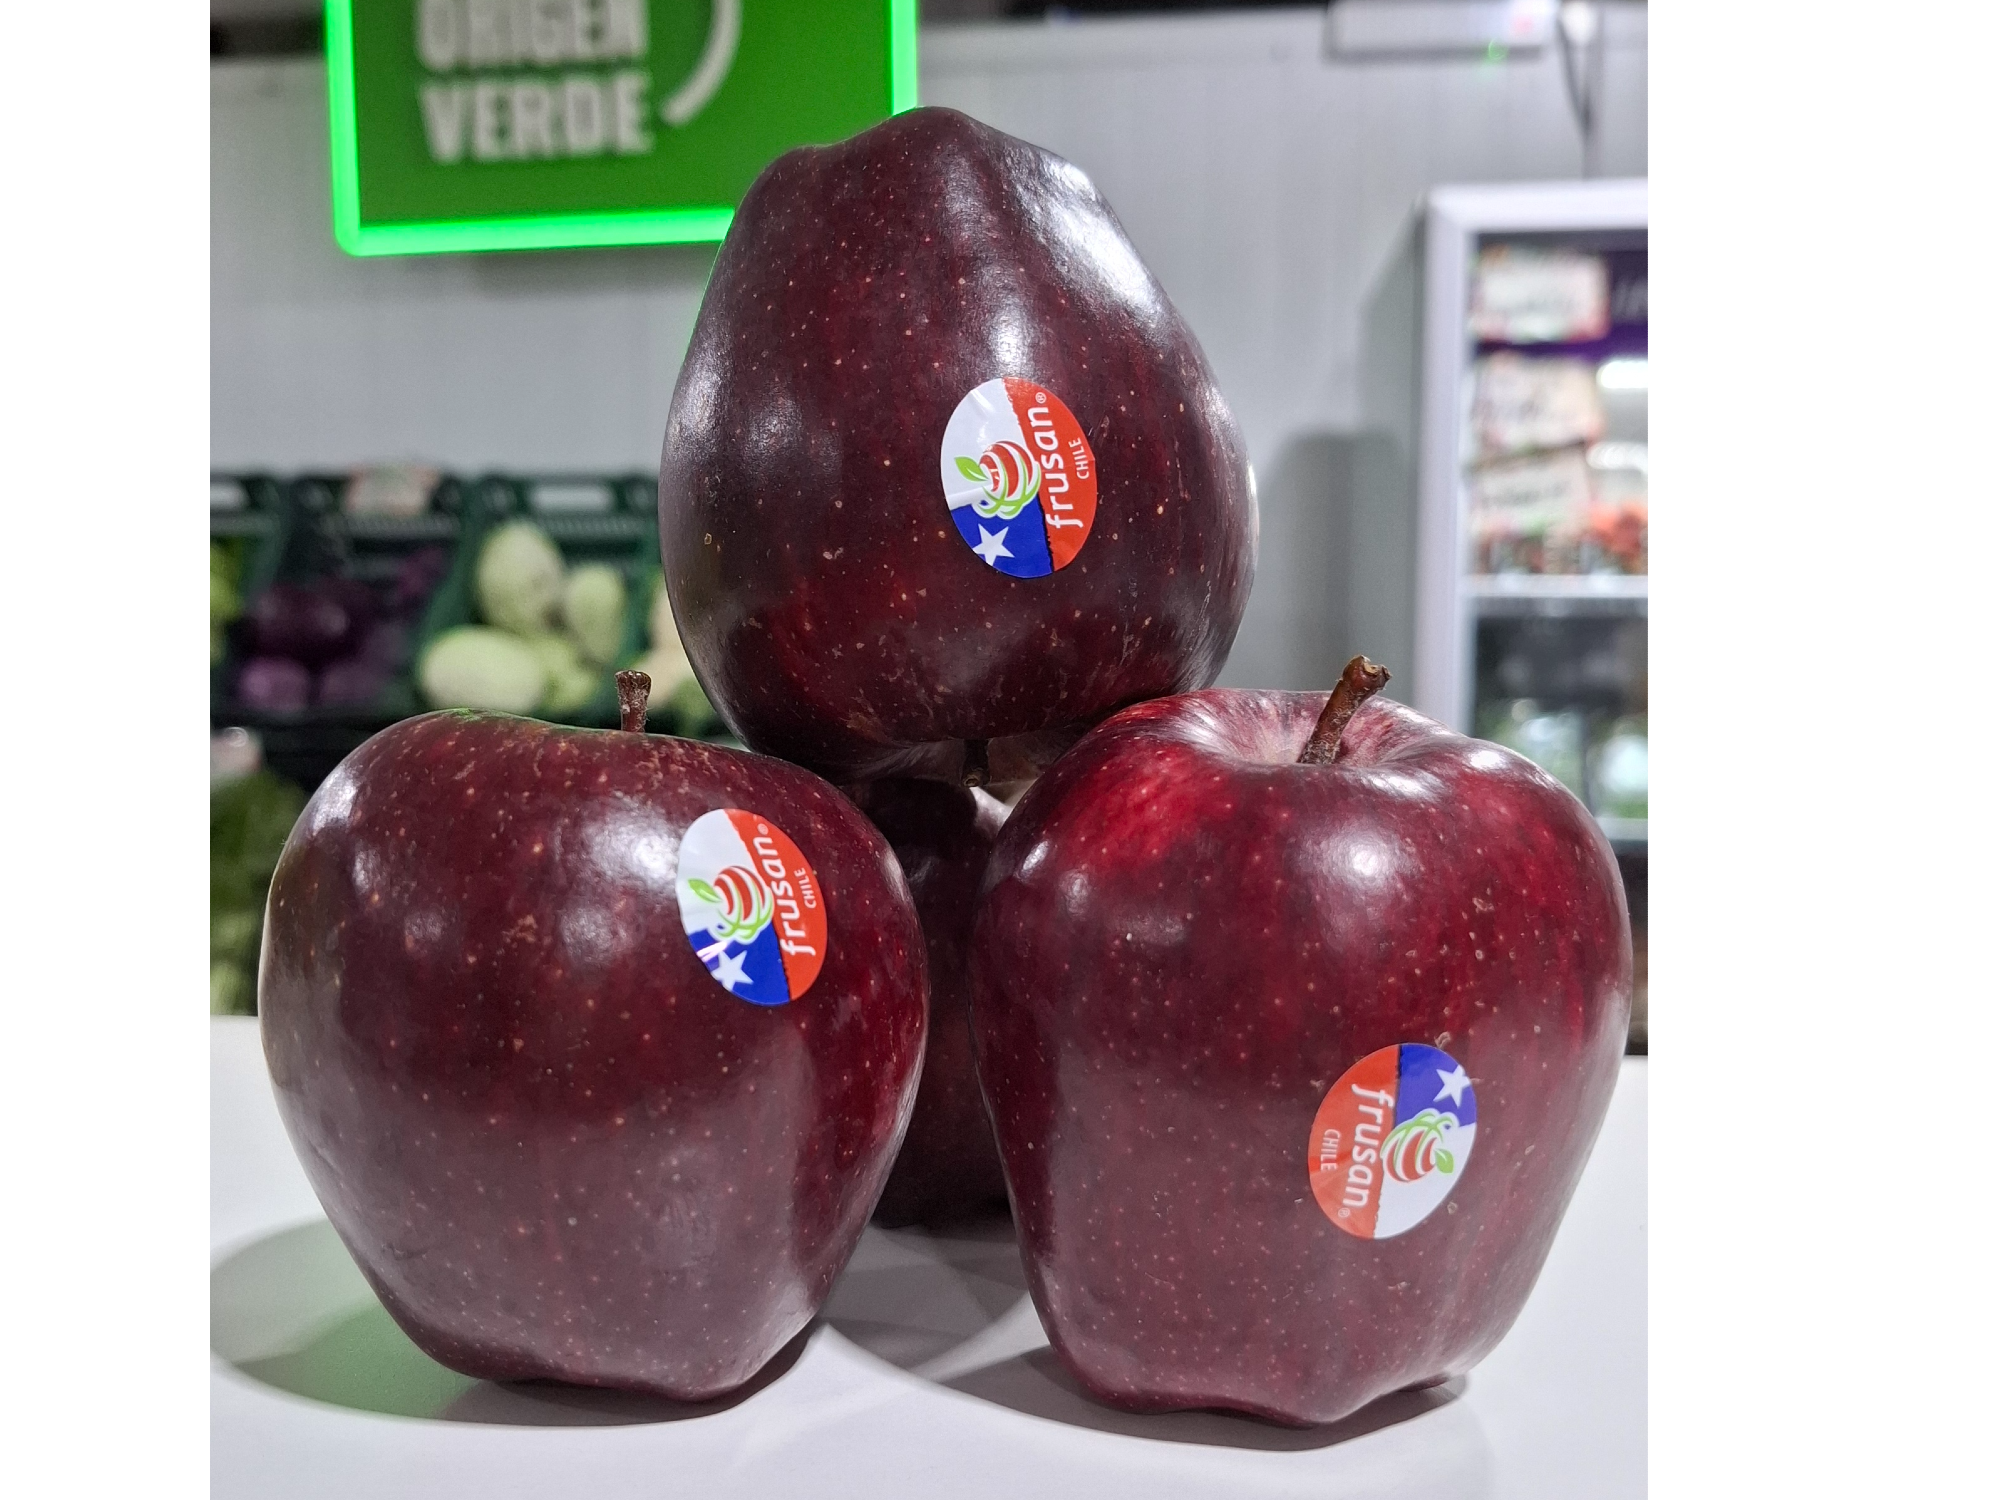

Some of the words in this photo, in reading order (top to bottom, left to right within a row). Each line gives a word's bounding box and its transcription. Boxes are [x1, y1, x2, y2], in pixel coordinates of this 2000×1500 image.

[421, 73, 654, 163] VERDE
[1068, 438, 1089, 480] CHILE
[795, 868, 816, 908] CHILE
[1321, 1129, 1341, 1171] CHILE
